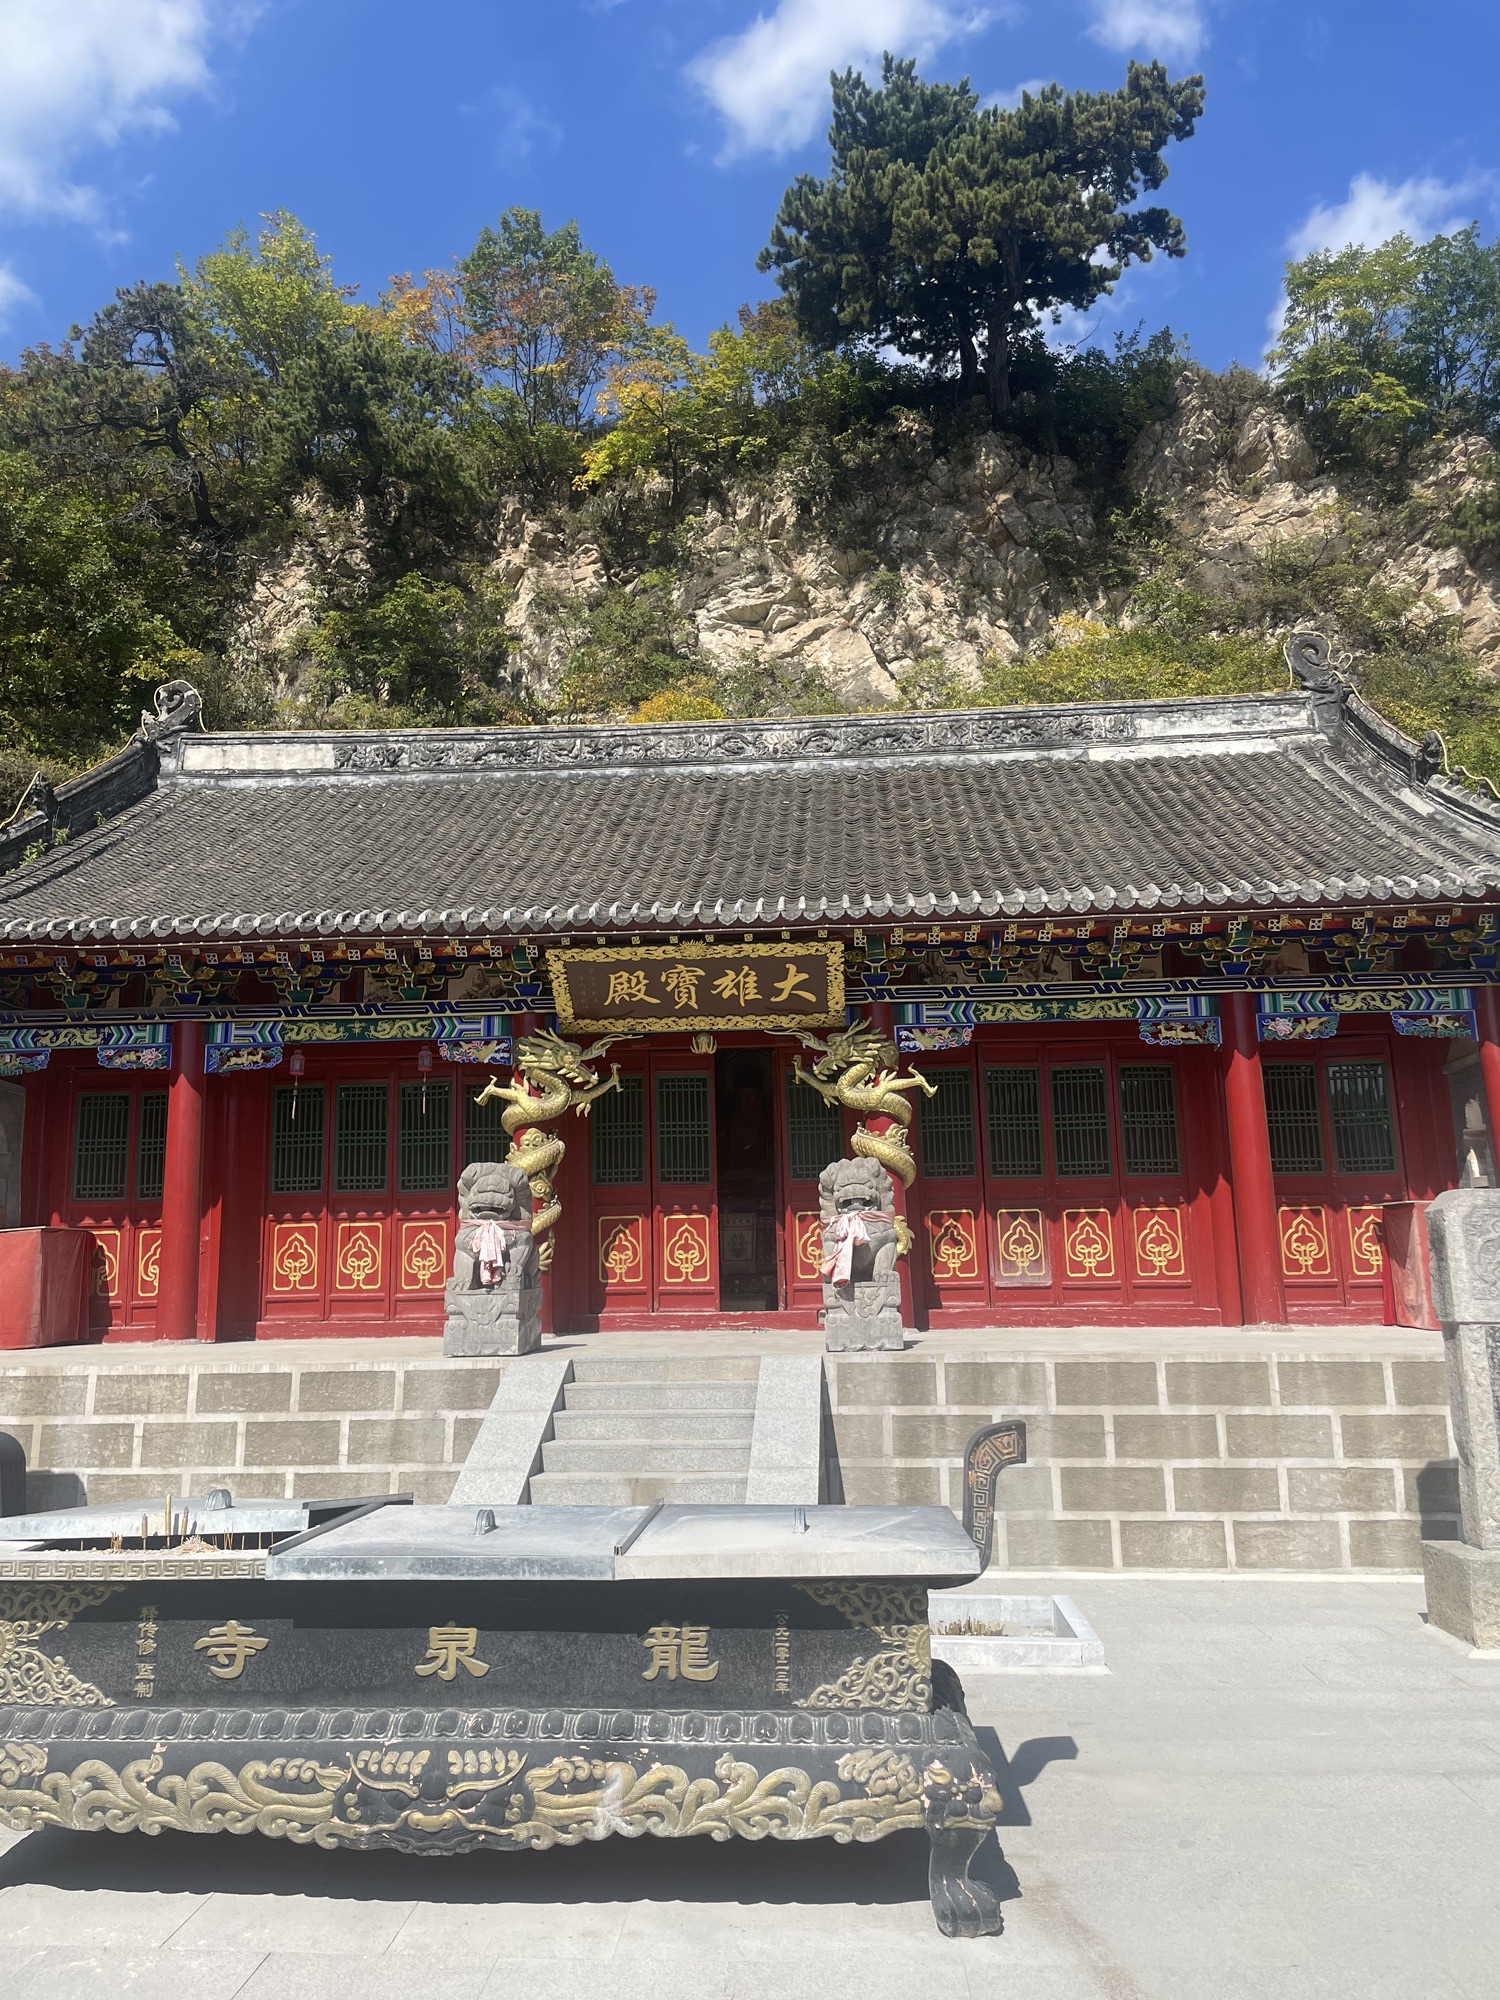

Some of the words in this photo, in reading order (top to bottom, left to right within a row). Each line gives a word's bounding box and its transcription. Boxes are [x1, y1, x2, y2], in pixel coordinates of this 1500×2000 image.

[603, 963, 817, 1010] 大雄寶殿
[194, 1620, 719, 1682] 龍泉寺
